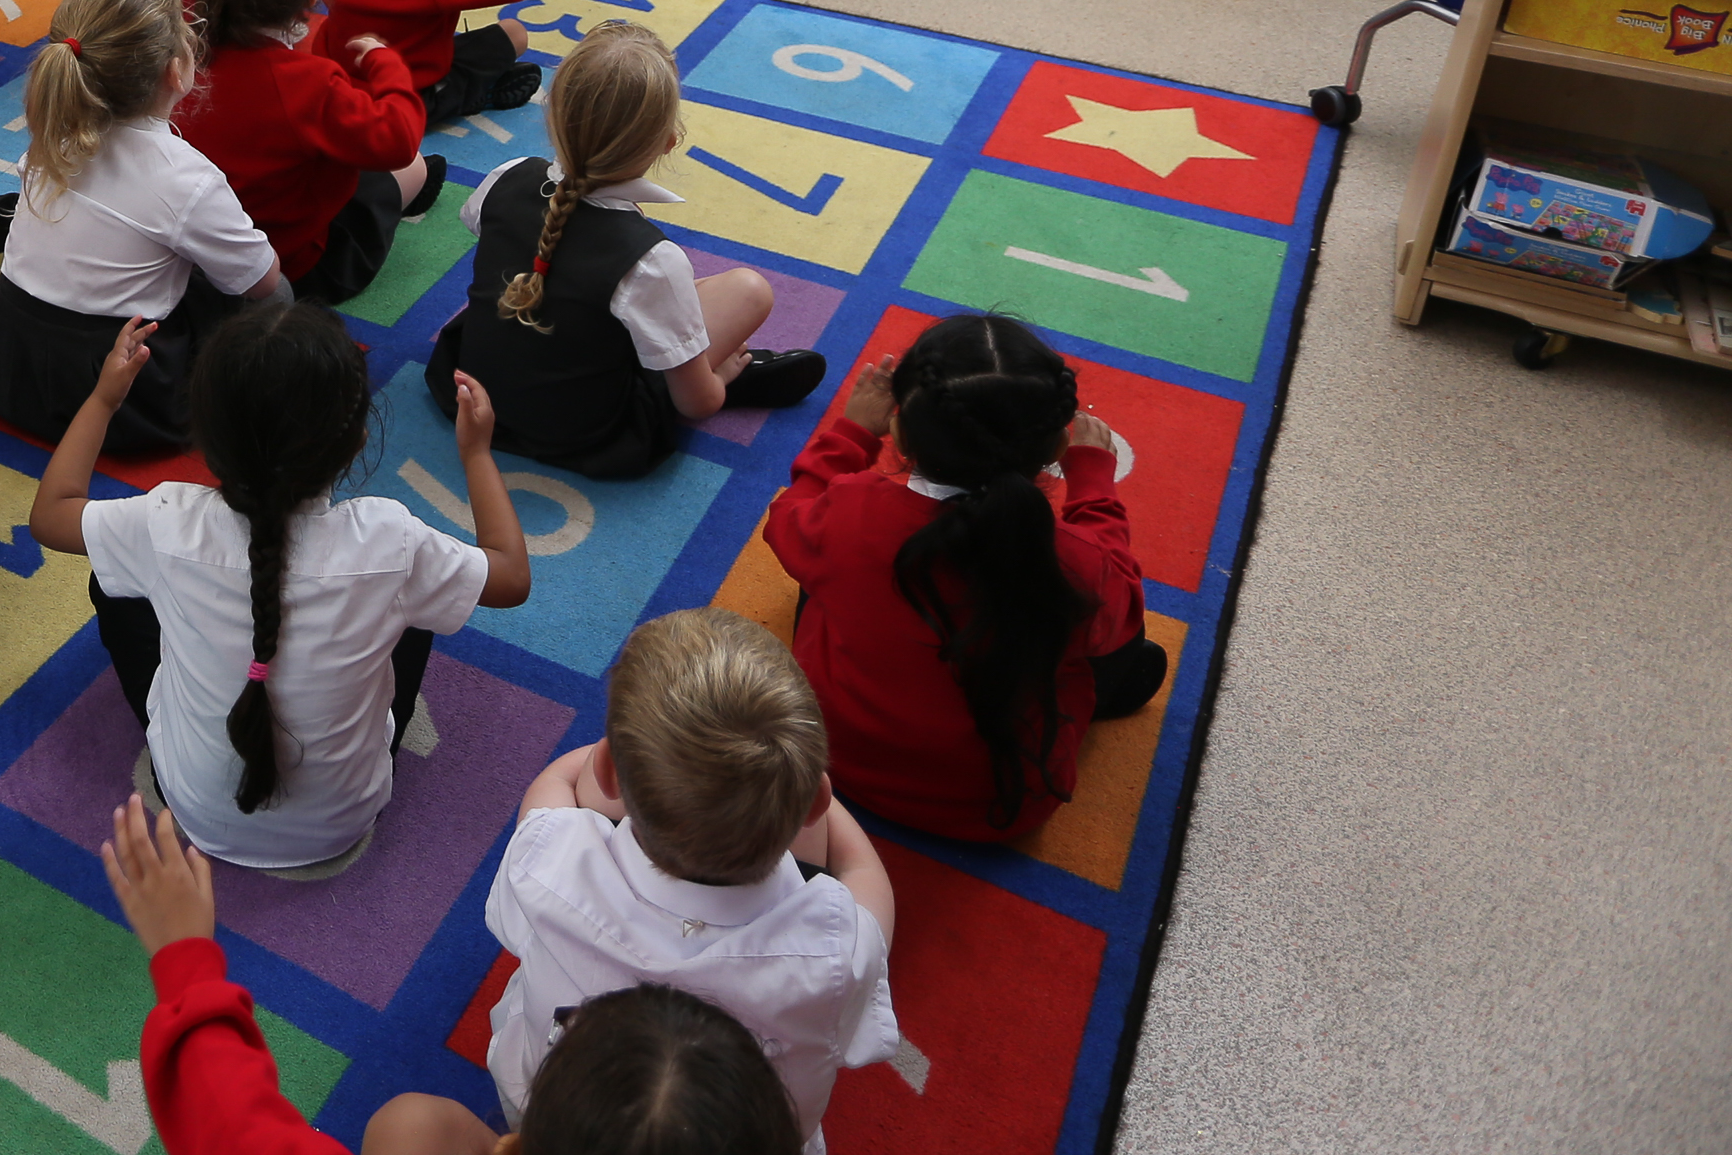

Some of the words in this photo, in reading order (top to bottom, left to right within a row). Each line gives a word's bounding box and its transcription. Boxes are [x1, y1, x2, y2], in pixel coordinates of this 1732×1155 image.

[1616, 16, 1666, 34] Phonics
[1677, 15, 1715, 30] Book
[1681, 26, 1706, 40] Big
[687, 145, 844, 217] 7
[1003, 246, 1190, 303] 1
